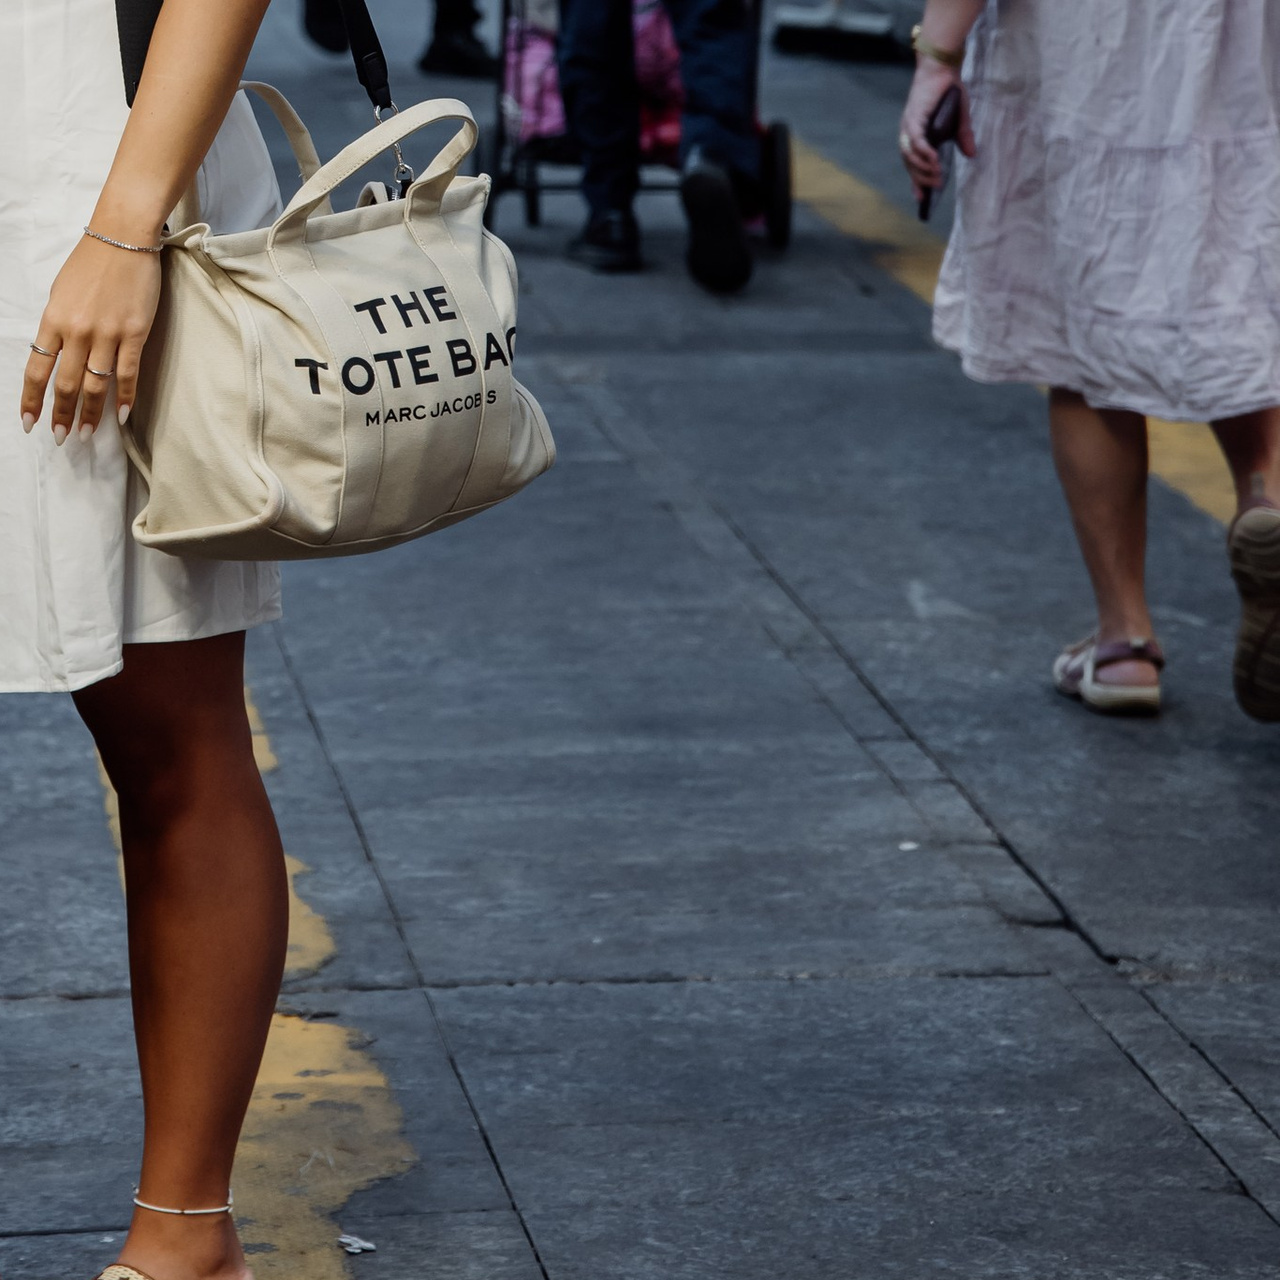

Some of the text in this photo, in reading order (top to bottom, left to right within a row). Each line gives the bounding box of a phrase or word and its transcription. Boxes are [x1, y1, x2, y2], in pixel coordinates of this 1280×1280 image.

[353, 285, 458, 335] THE
[294, 345, 440, 396] TOTE
[365, 389, 498, 427] MARC JACOBS
